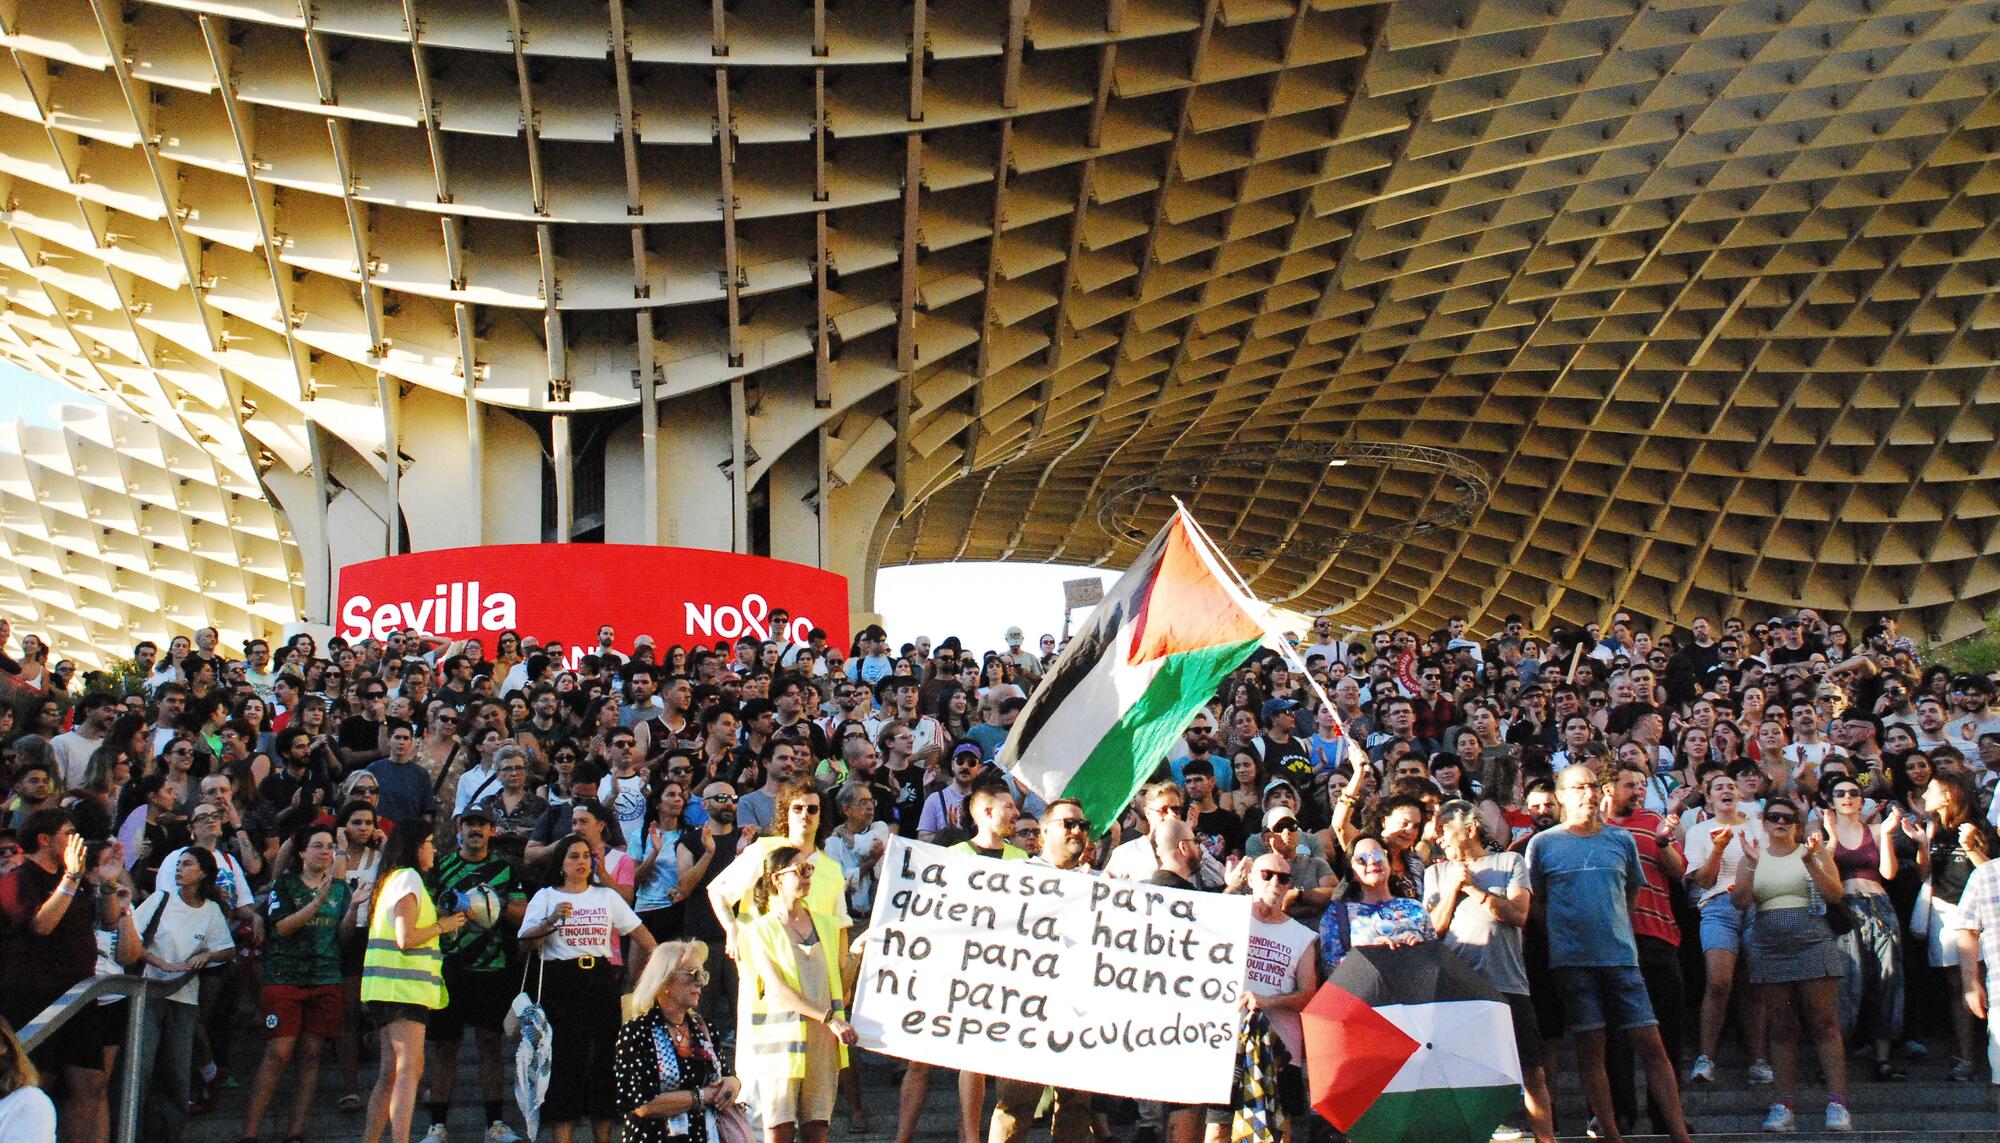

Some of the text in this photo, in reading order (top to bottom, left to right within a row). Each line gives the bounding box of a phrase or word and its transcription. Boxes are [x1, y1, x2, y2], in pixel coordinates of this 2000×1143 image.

[341, 581, 517, 647] Sevilla
[571, 907, 606, 916] INDICATO
[900, 846, 1197, 923] La casa para
[891, 889, 1234, 965] quien la habita
[882, 927, 1238, 1004] no para bancos
[1247, 946, 1289, 966] QUILINAS
[1248, 970, 1282, 988] SEVILLA
[876, 968, 1048, 1022] ni para
[901, 1010, 1233, 1053] especuculadores
